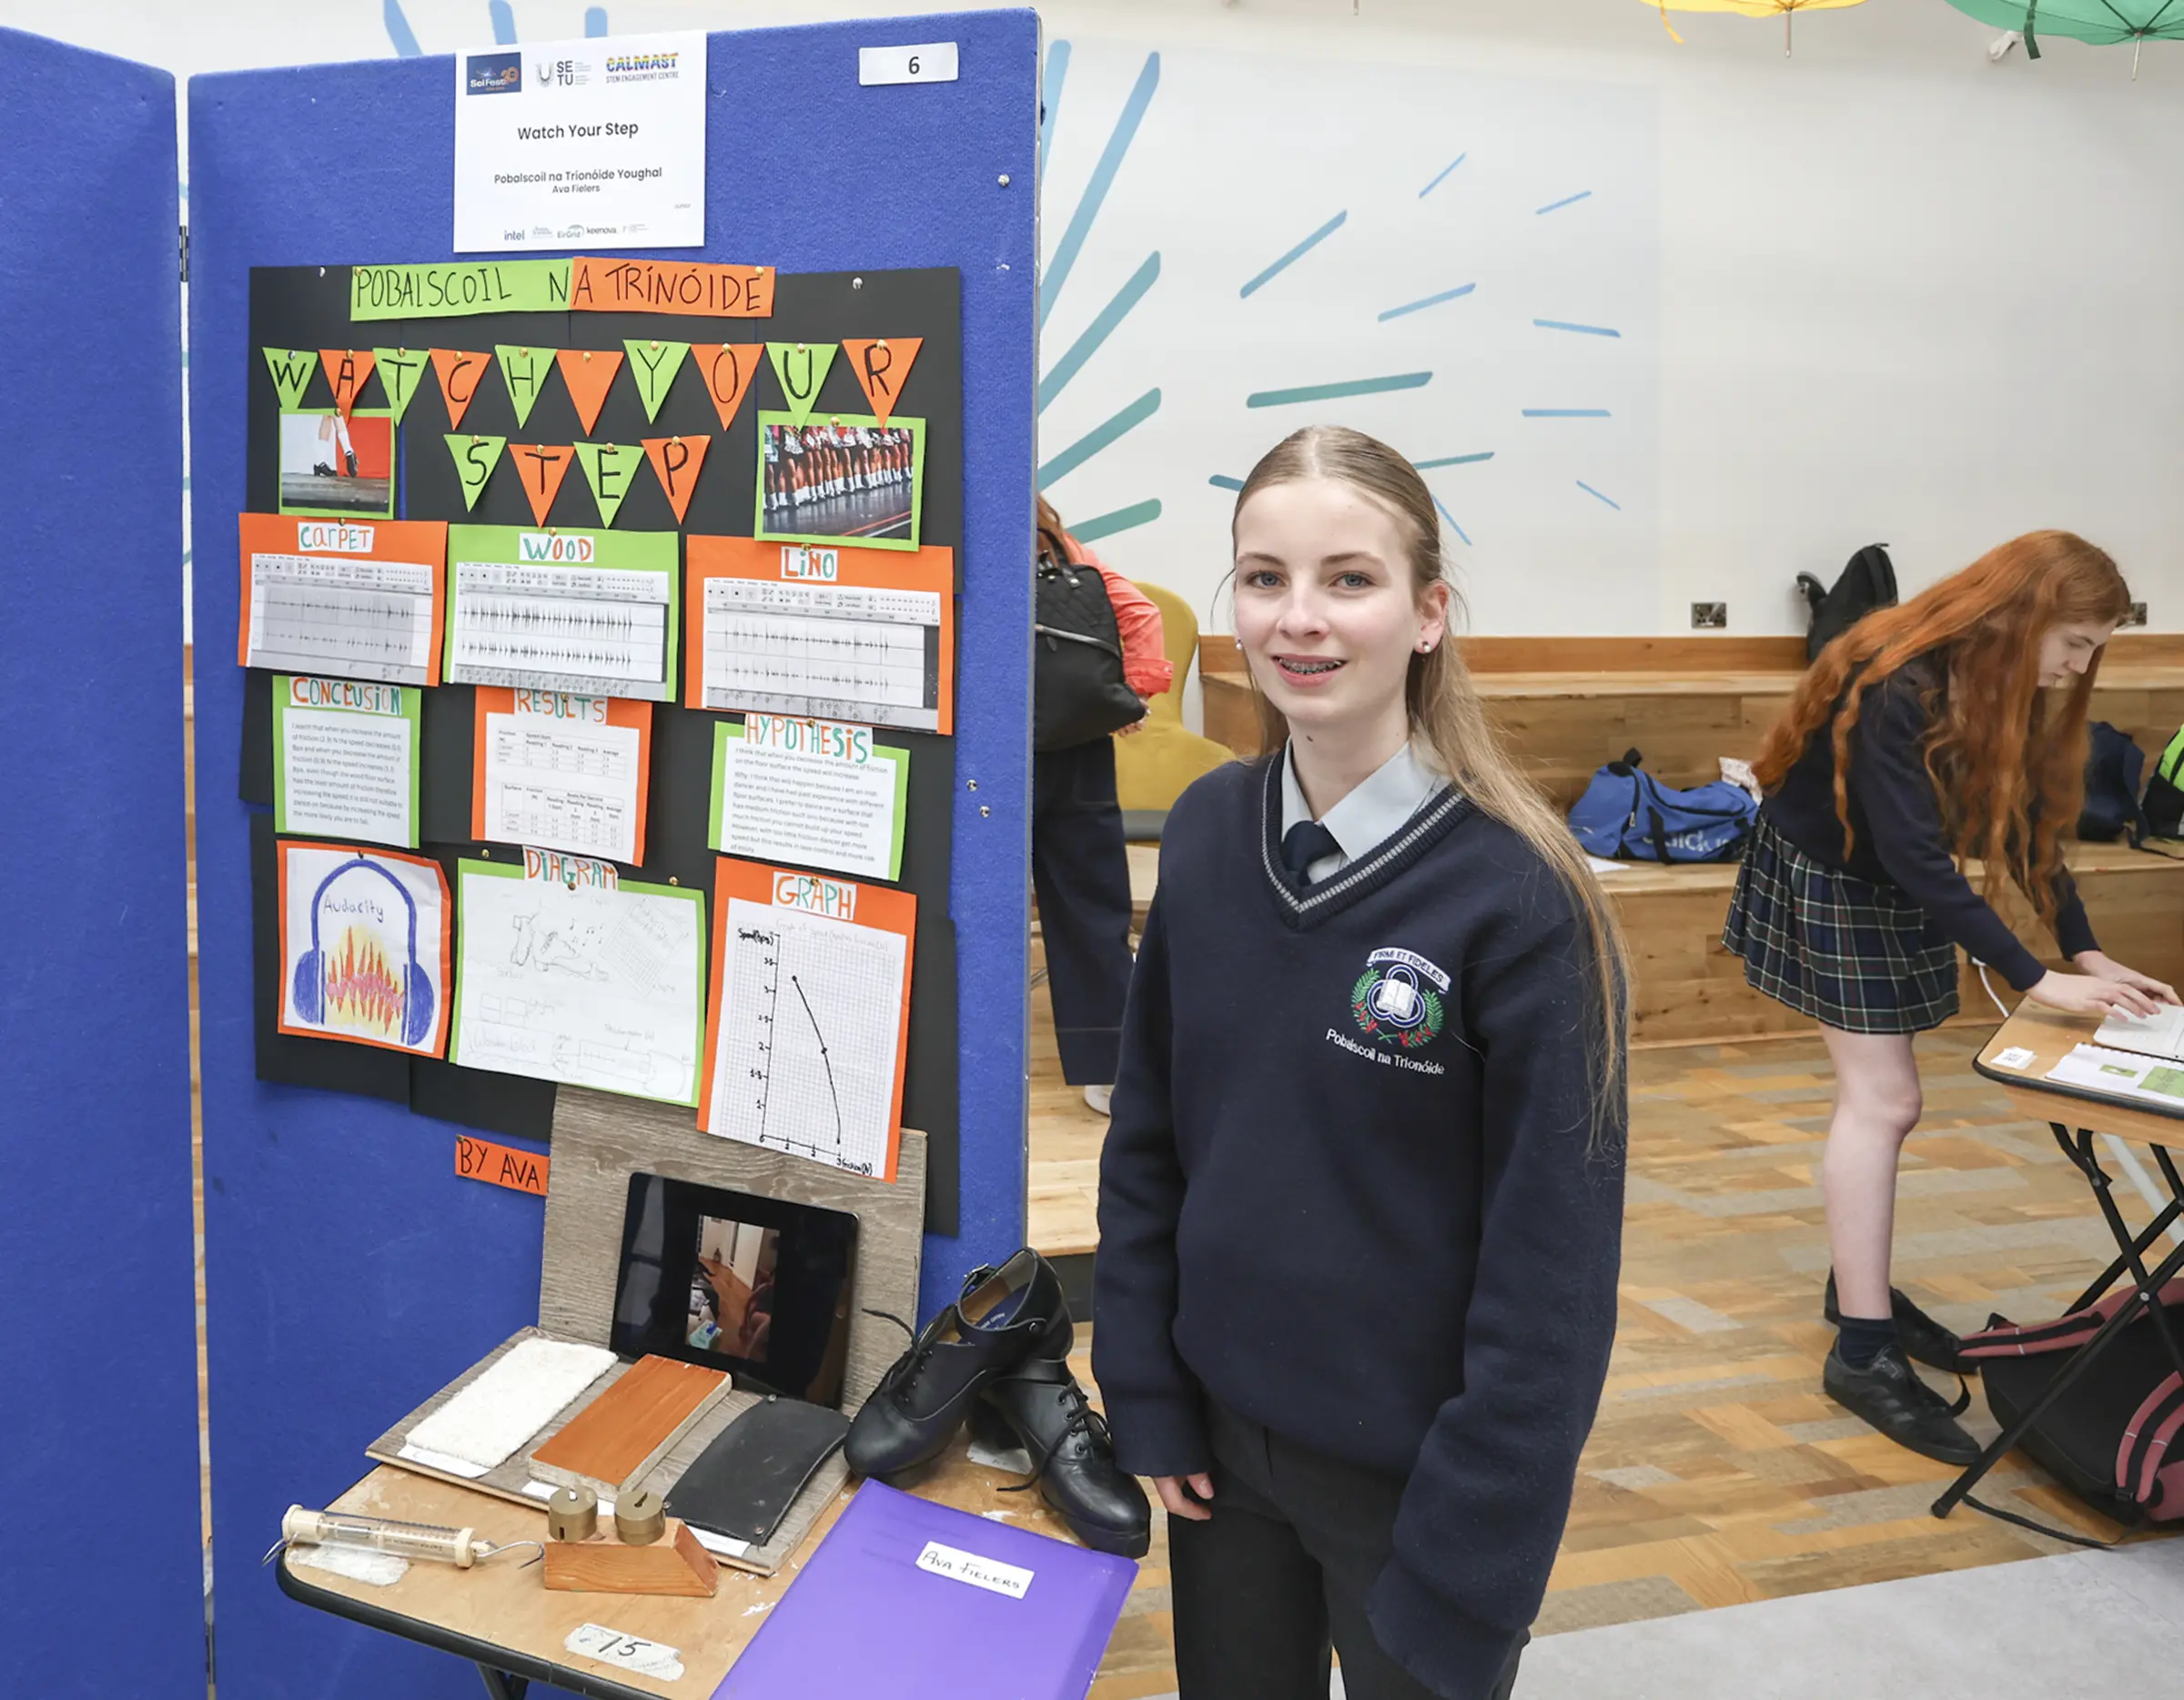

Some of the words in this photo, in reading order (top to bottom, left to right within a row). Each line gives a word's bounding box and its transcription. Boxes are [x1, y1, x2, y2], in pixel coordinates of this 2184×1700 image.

[557, 61, 573, 73] SE
[606, 53, 679, 73] CALMAST
[908, 56, 920, 75] 6
[557, 75, 573, 86] TU
[518, 126, 564, 140] Watch
[569, 124, 602, 137] Your
[605, 122, 639, 140] Step
[494, 170, 546, 184] Pobalscoil
[549, 172, 562, 182] na
[617, 167, 662, 182] Youghal
[571, 184, 601, 193] Fielers
[504, 229, 525, 240] intel
[357, 268, 513, 309] POBALSCOIL
[550, 264, 593, 306] NA
[273, 349, 536, 404] WATCH
[637, 341, 895, 406] YOUR
[465, 440, 689, 501] STEP
[522, 538, 592, 562] WOOD
[516, 688, 605, 724] RESULTS
[776, 875, 852, 919] GRAPH
[324, 893, 384, 923] Audacity
[1396, 952, 1407, 960] ET
[1409, 955, 1444, 983] FIDELES
[759, 1041, 764, 1051] 2
[1378, 1052, 1391, 1065] na
[757, 1099, 762, 1109] 1
[812, 1149, 816, 1158] 2
[459, 1138, 488, 1174] BY
[499, 1152, 541, 1190] AVA
[598, 1636, 652, 1657] 15
